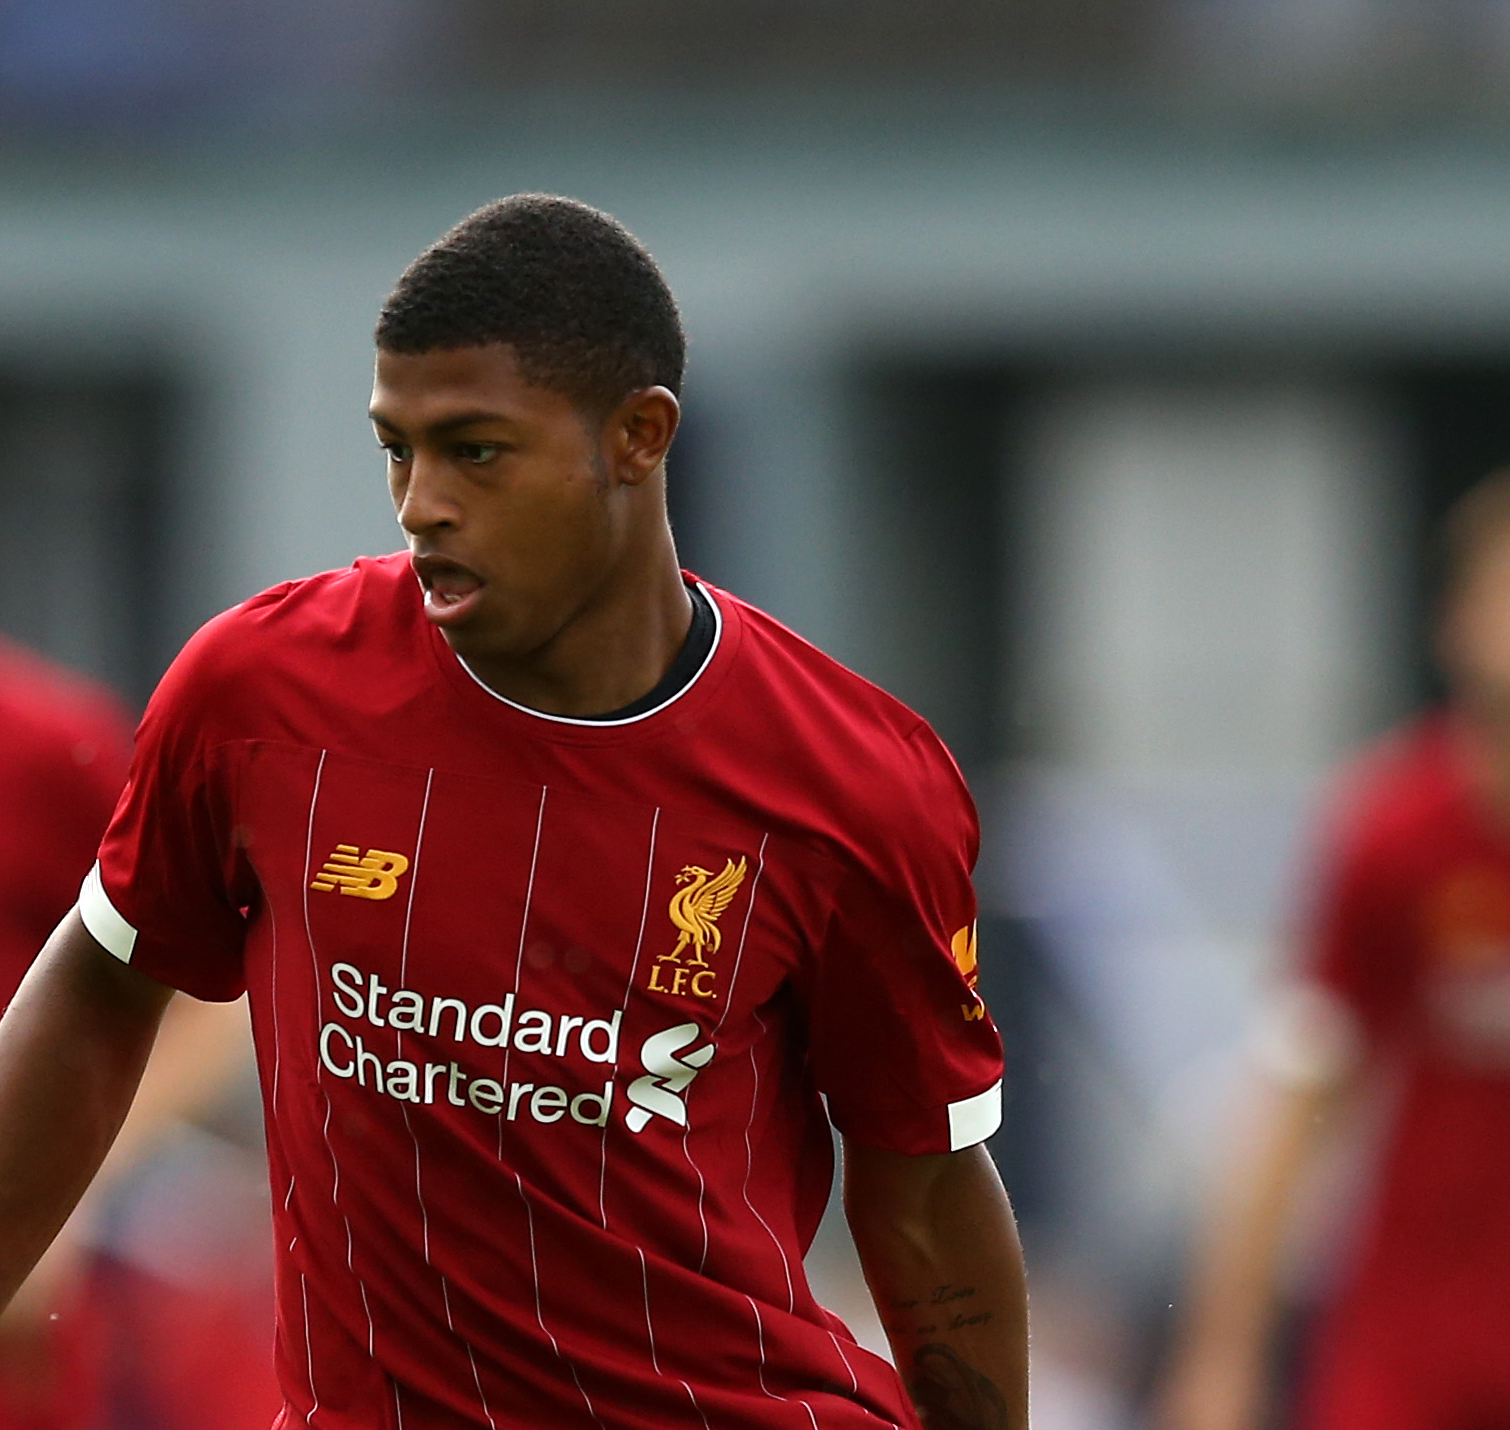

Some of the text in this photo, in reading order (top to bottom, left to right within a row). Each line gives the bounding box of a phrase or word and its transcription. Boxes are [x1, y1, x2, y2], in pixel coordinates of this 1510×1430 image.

[331, 962, 623, 1063] Standard
[647, 965, 717, 998] L.F.C.
[319, 1022, 614, 1127] Chartered
